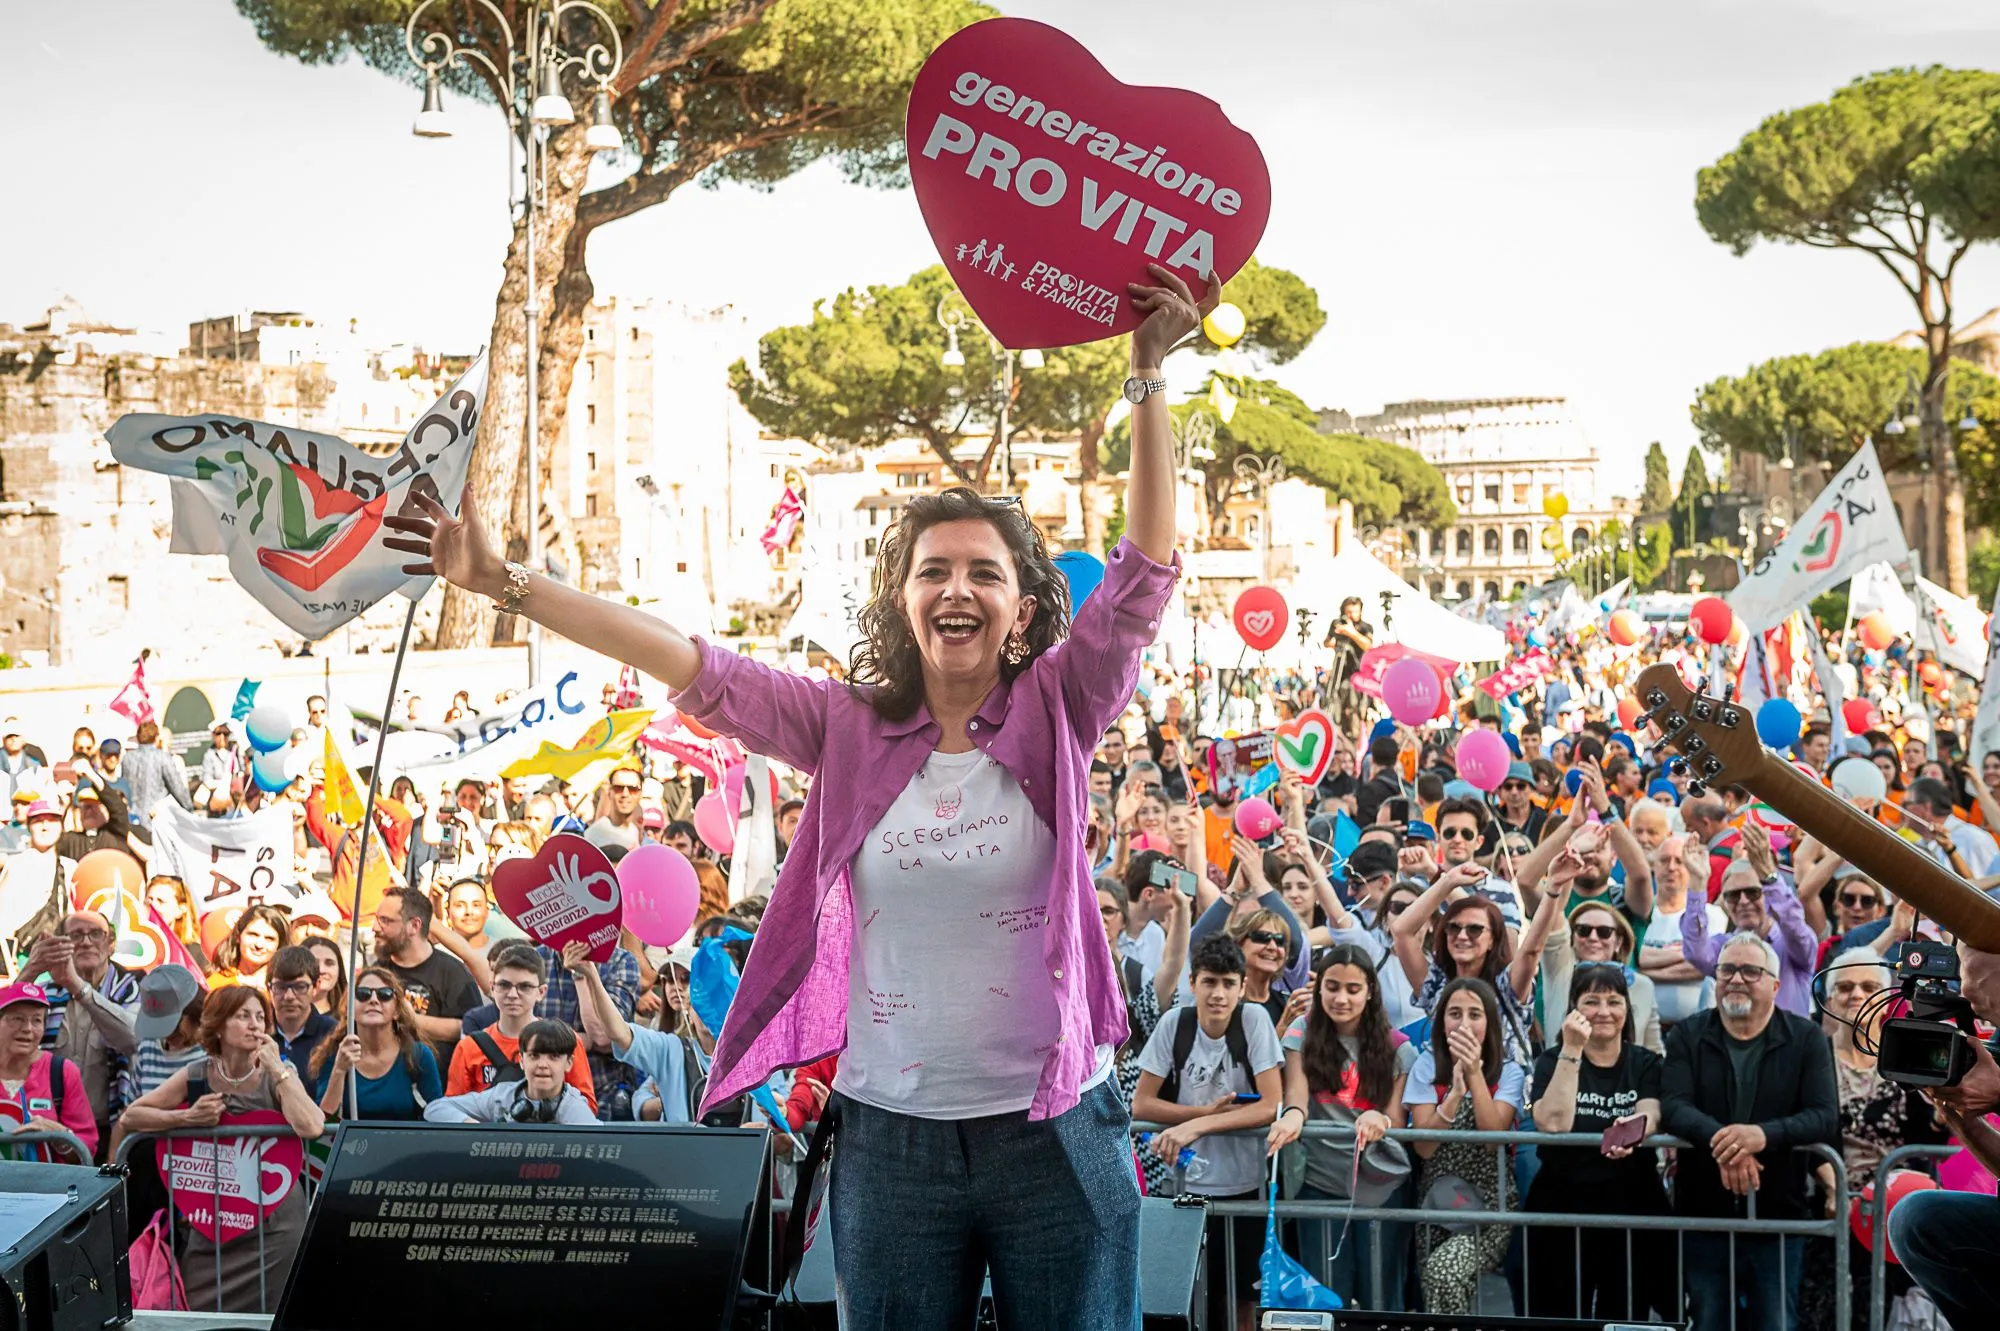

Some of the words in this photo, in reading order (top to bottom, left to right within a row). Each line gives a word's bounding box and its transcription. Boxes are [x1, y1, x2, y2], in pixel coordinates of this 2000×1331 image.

[950, 72, 1242, 216] generazione
[922, 113, 1067, 207] PRO
[1081, 177, 1214, 281] VITA
[1028, 260, 1119, 312] PROVITA
[1021, 277, 1036, 292] &
[1036, 283, 1115, 327] FAMIGLIA
[882, 815, 1008, 853] SCEGLIAMO
[900, 858, 923, 870] LA
[942, 844, 1001, 861] VITA
[523, 900, 561, 928] provita
[540, 906, 589, 936] speranza
[469, 1141, 523, 1158] SIAMO
[584, 1144, 595, 1159] E
[176, 1175, 241, 1195] speranza
[348, 1180, 374, 1196] HO
[375, 1180, 428, 1197] PRESO
[429, 1181, 449, 1197] LA
[451, 1183, 532, 1199] CHITARRA
[535, 1185, 585, 1200] SENZA
[378, 1199, 390, 1217] È
[391, 1201, 439, 1218] BELLO
[441, 1203, 498, 1220] VIVERE
[499, 1204, 555, 1221] ANCHE
[556, 1206, 576, 1221] SE
[579, 1206, 598, 1221] SI
[599, 1206, 631, 1223] STA
[349, 1221, 410, 1238] VOLEVO
[412, 1223, 478, 1240] DIRTELO
[609, 1228, 637, 1243] NEL
[406, 1244, 441, 1261] SON
